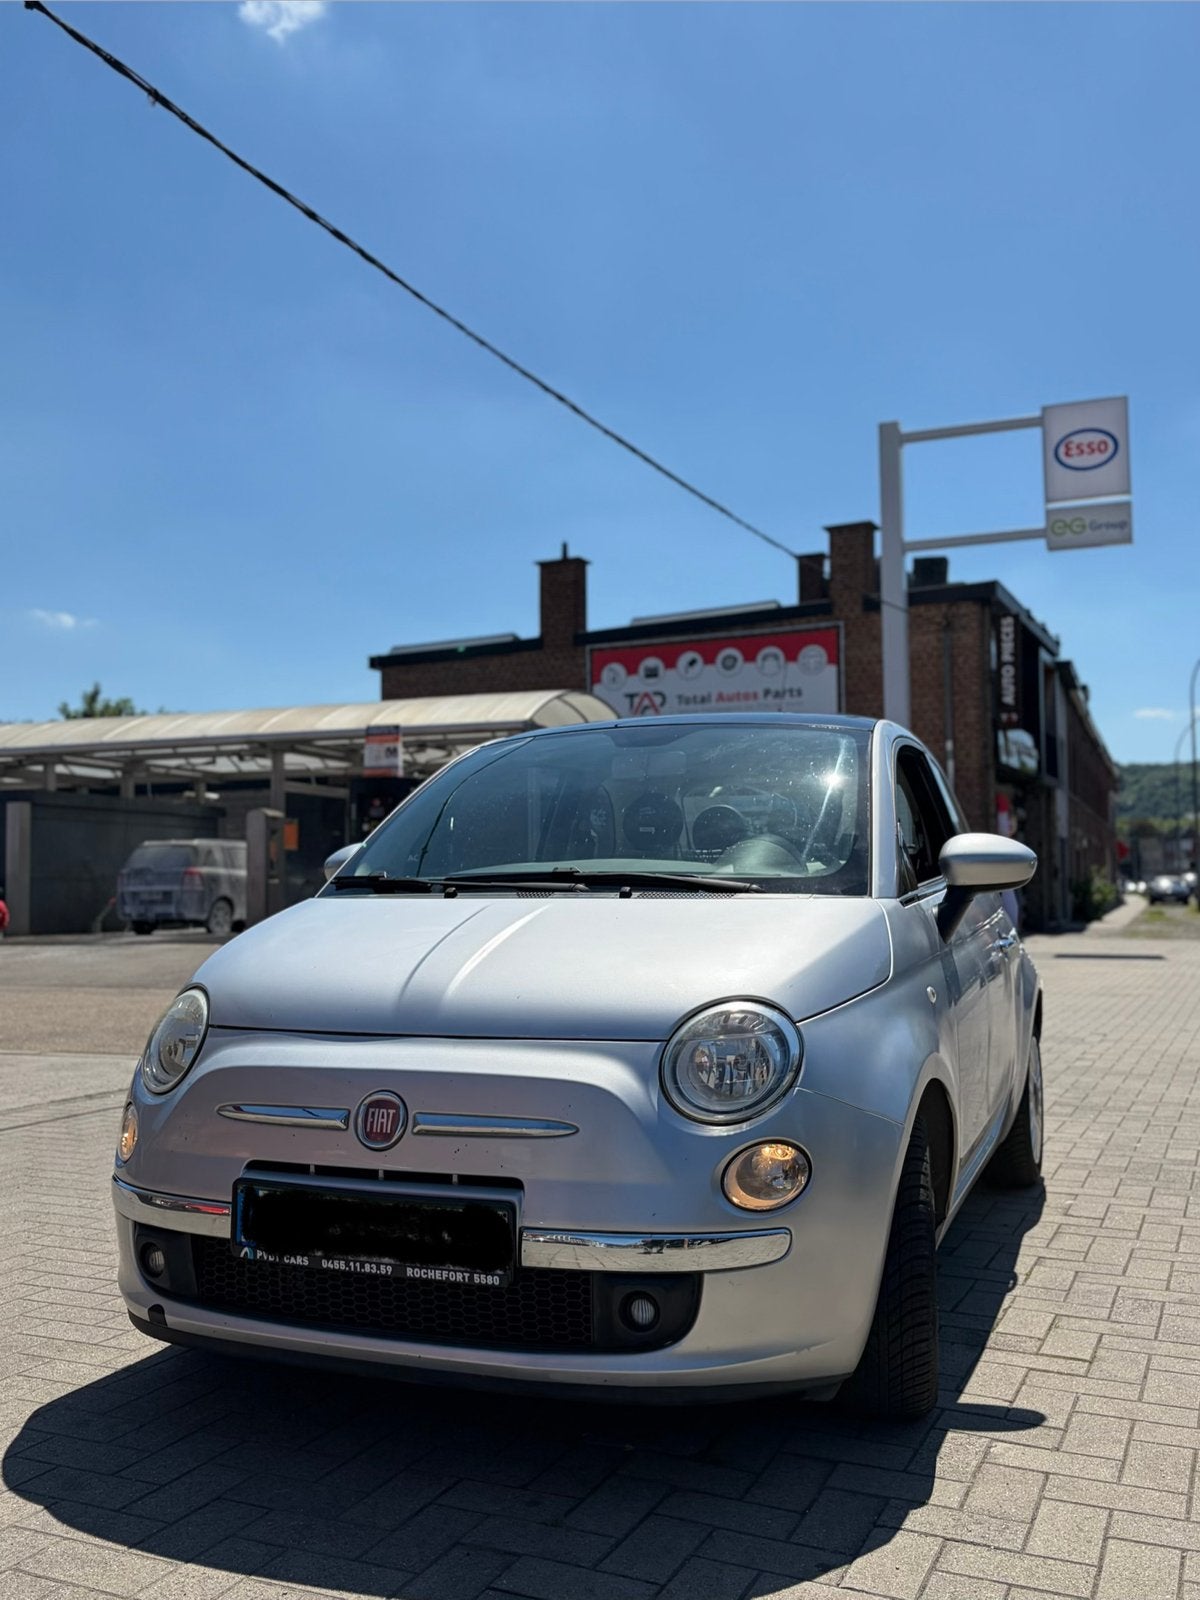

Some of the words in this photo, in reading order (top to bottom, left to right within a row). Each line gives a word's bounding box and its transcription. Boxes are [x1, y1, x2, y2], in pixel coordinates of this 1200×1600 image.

[676, 692, 712, 705] Total
[715, 688, 759, 704] Autos
[763, 687, 803, 700] Parts
[366, 1108, 396, 1133] FIAT
[283, 1255, 309, 1266] CARS
[321, 1259, 392, 1275] 0455.11.83.59
[406, 1267, 470, 1283] ROCHEFORT
[473, 1274, 500, 1286] 5580
